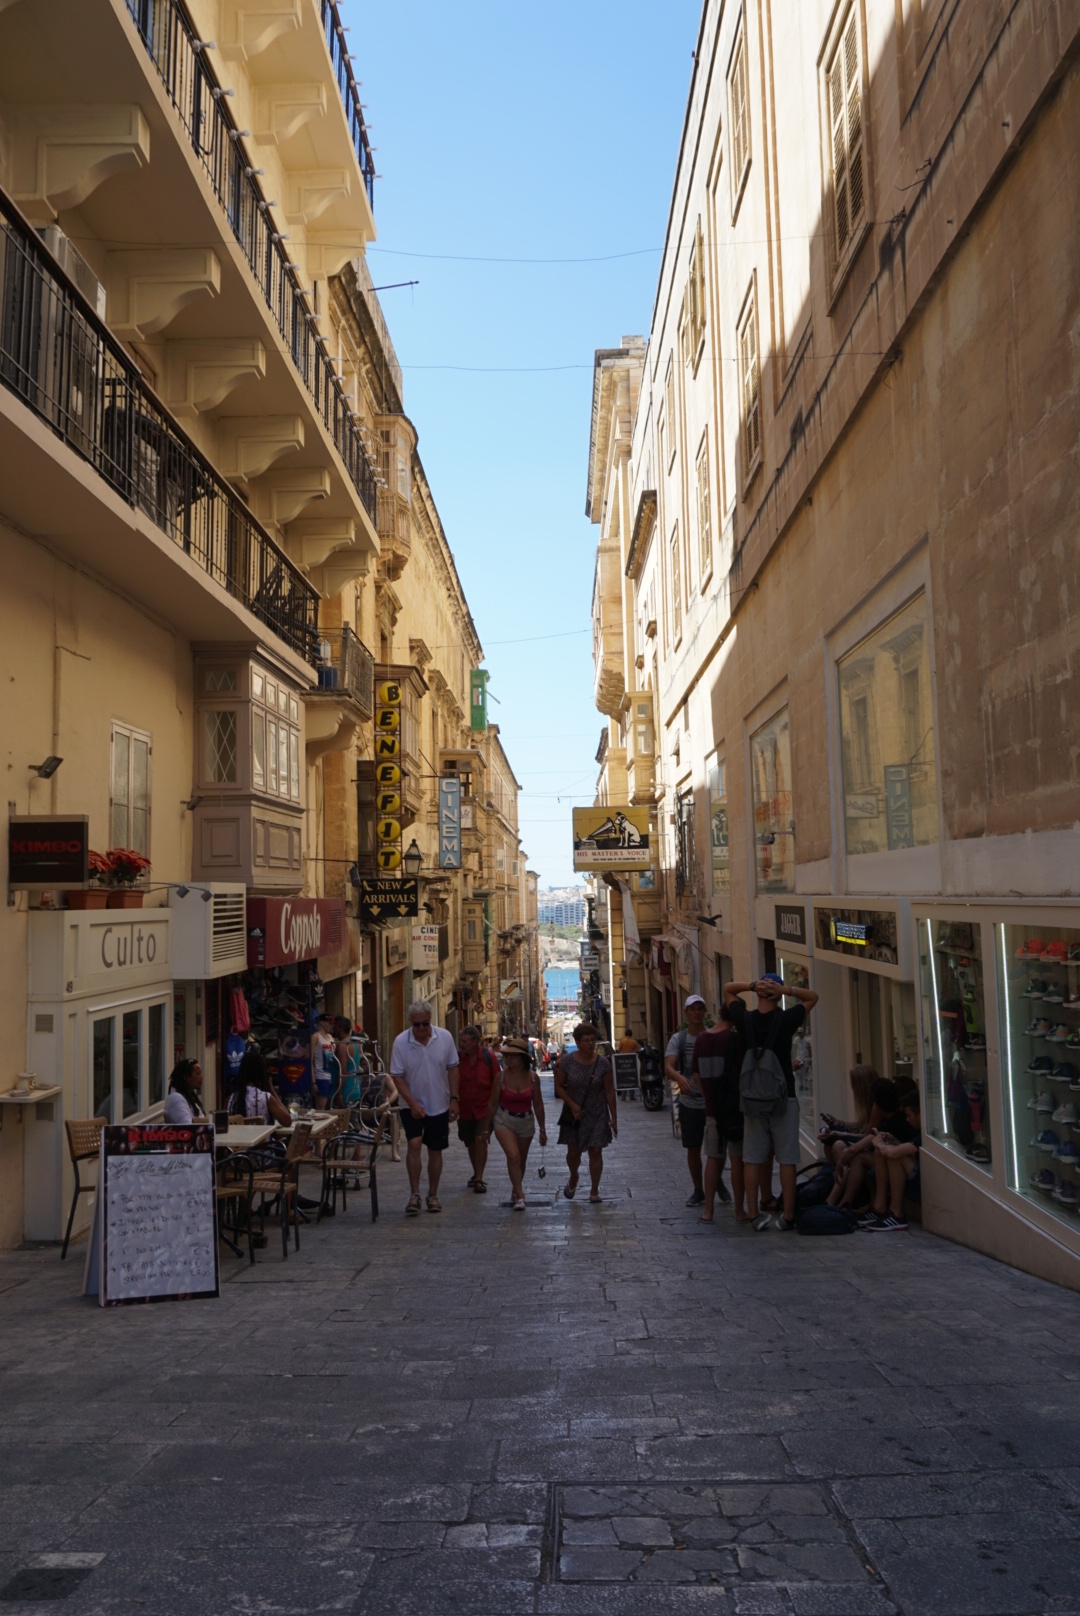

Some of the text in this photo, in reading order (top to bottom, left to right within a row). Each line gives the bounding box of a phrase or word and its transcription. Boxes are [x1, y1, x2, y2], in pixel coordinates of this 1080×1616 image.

[377, 683, 400, 868] BENEFIT
[442, 778, 458, 867] CINEMA
[12, 839, 83, 853] KIMBO
[377, 881, 402, 890] NEW
[362, 894, 416, 903] ARRIVALS
[280, 902, 321, 961] Coppola
[420, 926, 438, 934] CINE
[101, 923, 156, 968] Culto
[66, 981, 73, 993] 49
[128, 1129, 192, 1142] KIMBO
